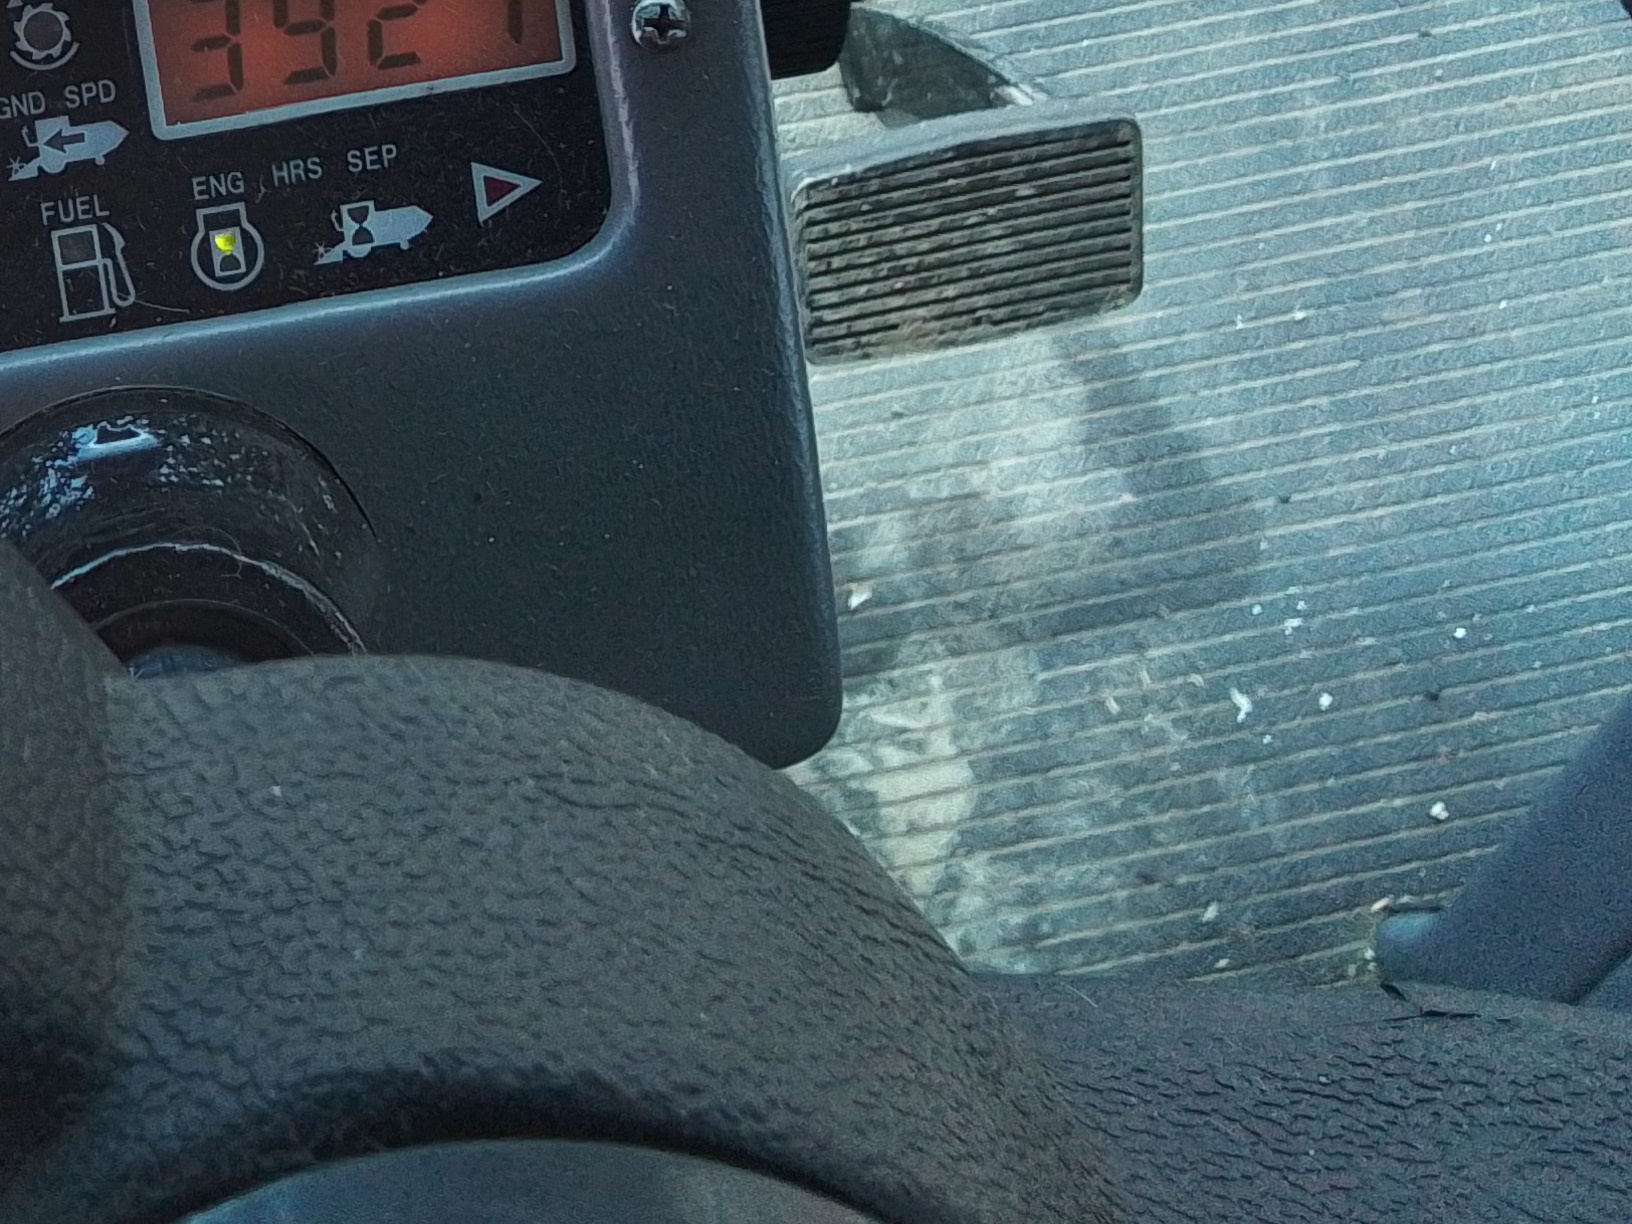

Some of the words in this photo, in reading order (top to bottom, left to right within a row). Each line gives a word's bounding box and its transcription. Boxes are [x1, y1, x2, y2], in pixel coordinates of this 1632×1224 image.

[64, 79, 116, 109] SPD
[191, 172, 245, 201] ENG
[271, 156, 323, 187] HRS
[346, 143, 398, 173] SEP
[40, 194, 110, 225] FUEL
